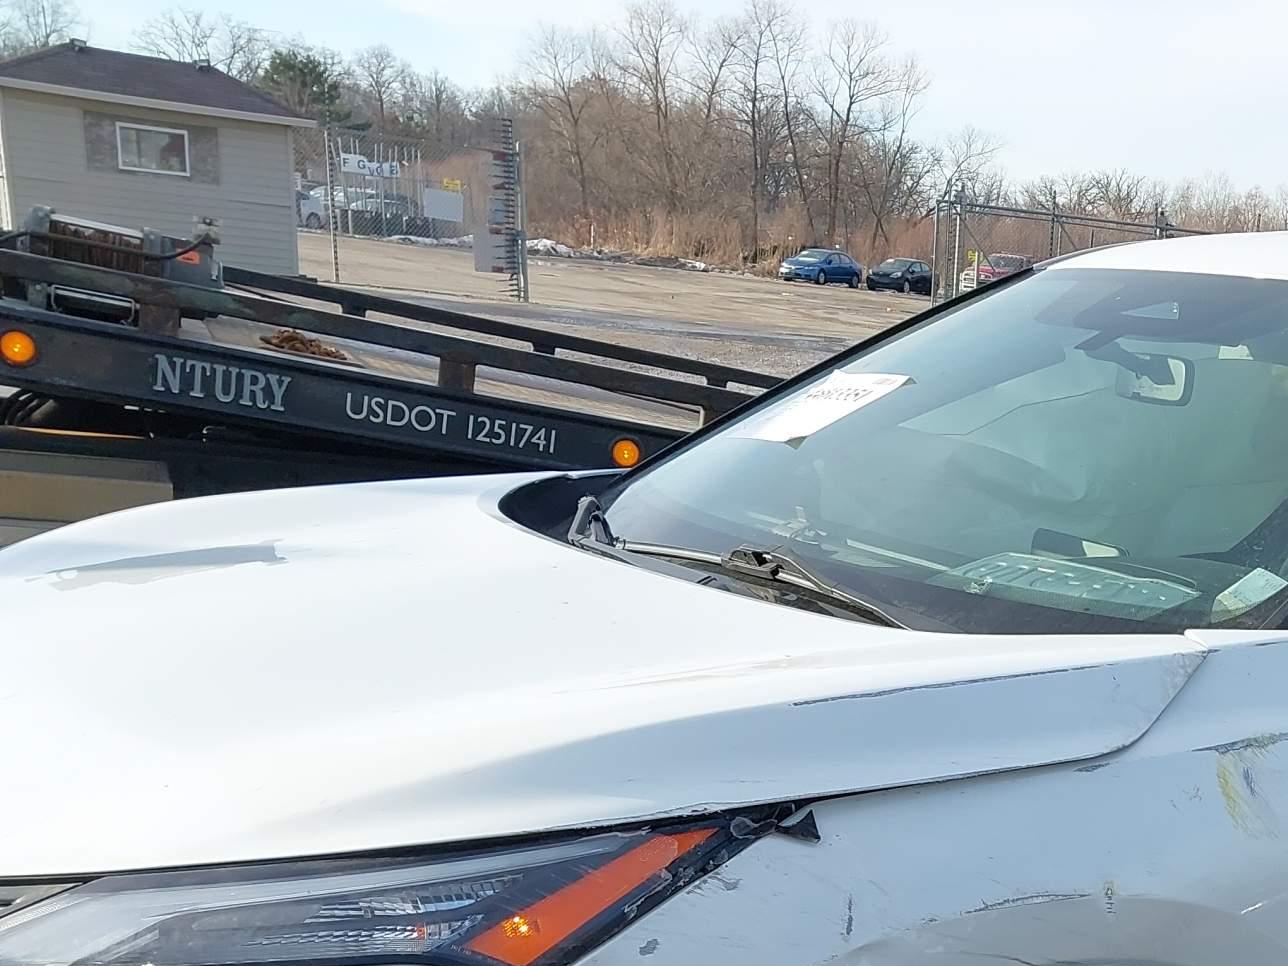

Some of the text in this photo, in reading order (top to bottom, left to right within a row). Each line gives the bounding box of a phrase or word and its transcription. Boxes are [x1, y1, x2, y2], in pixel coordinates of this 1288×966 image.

[153, 354, 292, 411] NTURY
[345, 392, 556, 454] USDOT 1251741
